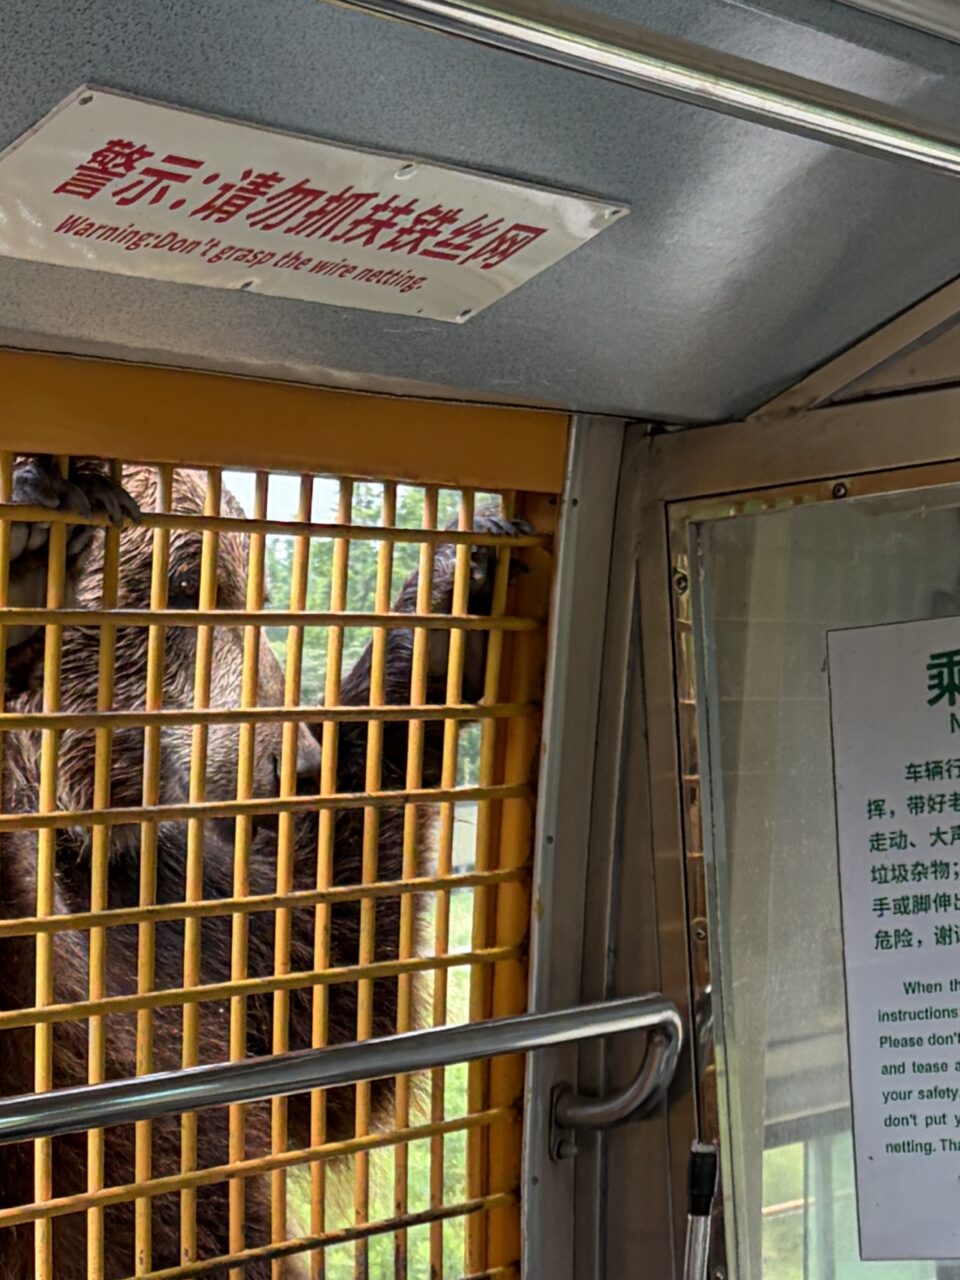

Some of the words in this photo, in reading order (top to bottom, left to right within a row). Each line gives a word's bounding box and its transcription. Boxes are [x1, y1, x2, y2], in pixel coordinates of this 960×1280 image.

[206, 245, 277, 269] grasp
[272, 250, 311, 271] the
[308, 258, 358, 279] wire
[351, 266, 428, 293] netting.
[905, 758, 960, 783] 车辆行
[903, 981, 943, 995] When
[878, 1005, 958, 1023] instructions
[880, 1035, 923, 1049] Please
[881, 1061, 906, 1076] and
[912, 1061, 949, 1074] tease
[882, 1089, 913, 1105] your
[883, 1114, 918, 1128] don't
[925, 1113, 947, 1129] put
[885, 1139, 936, 1157] netting.
